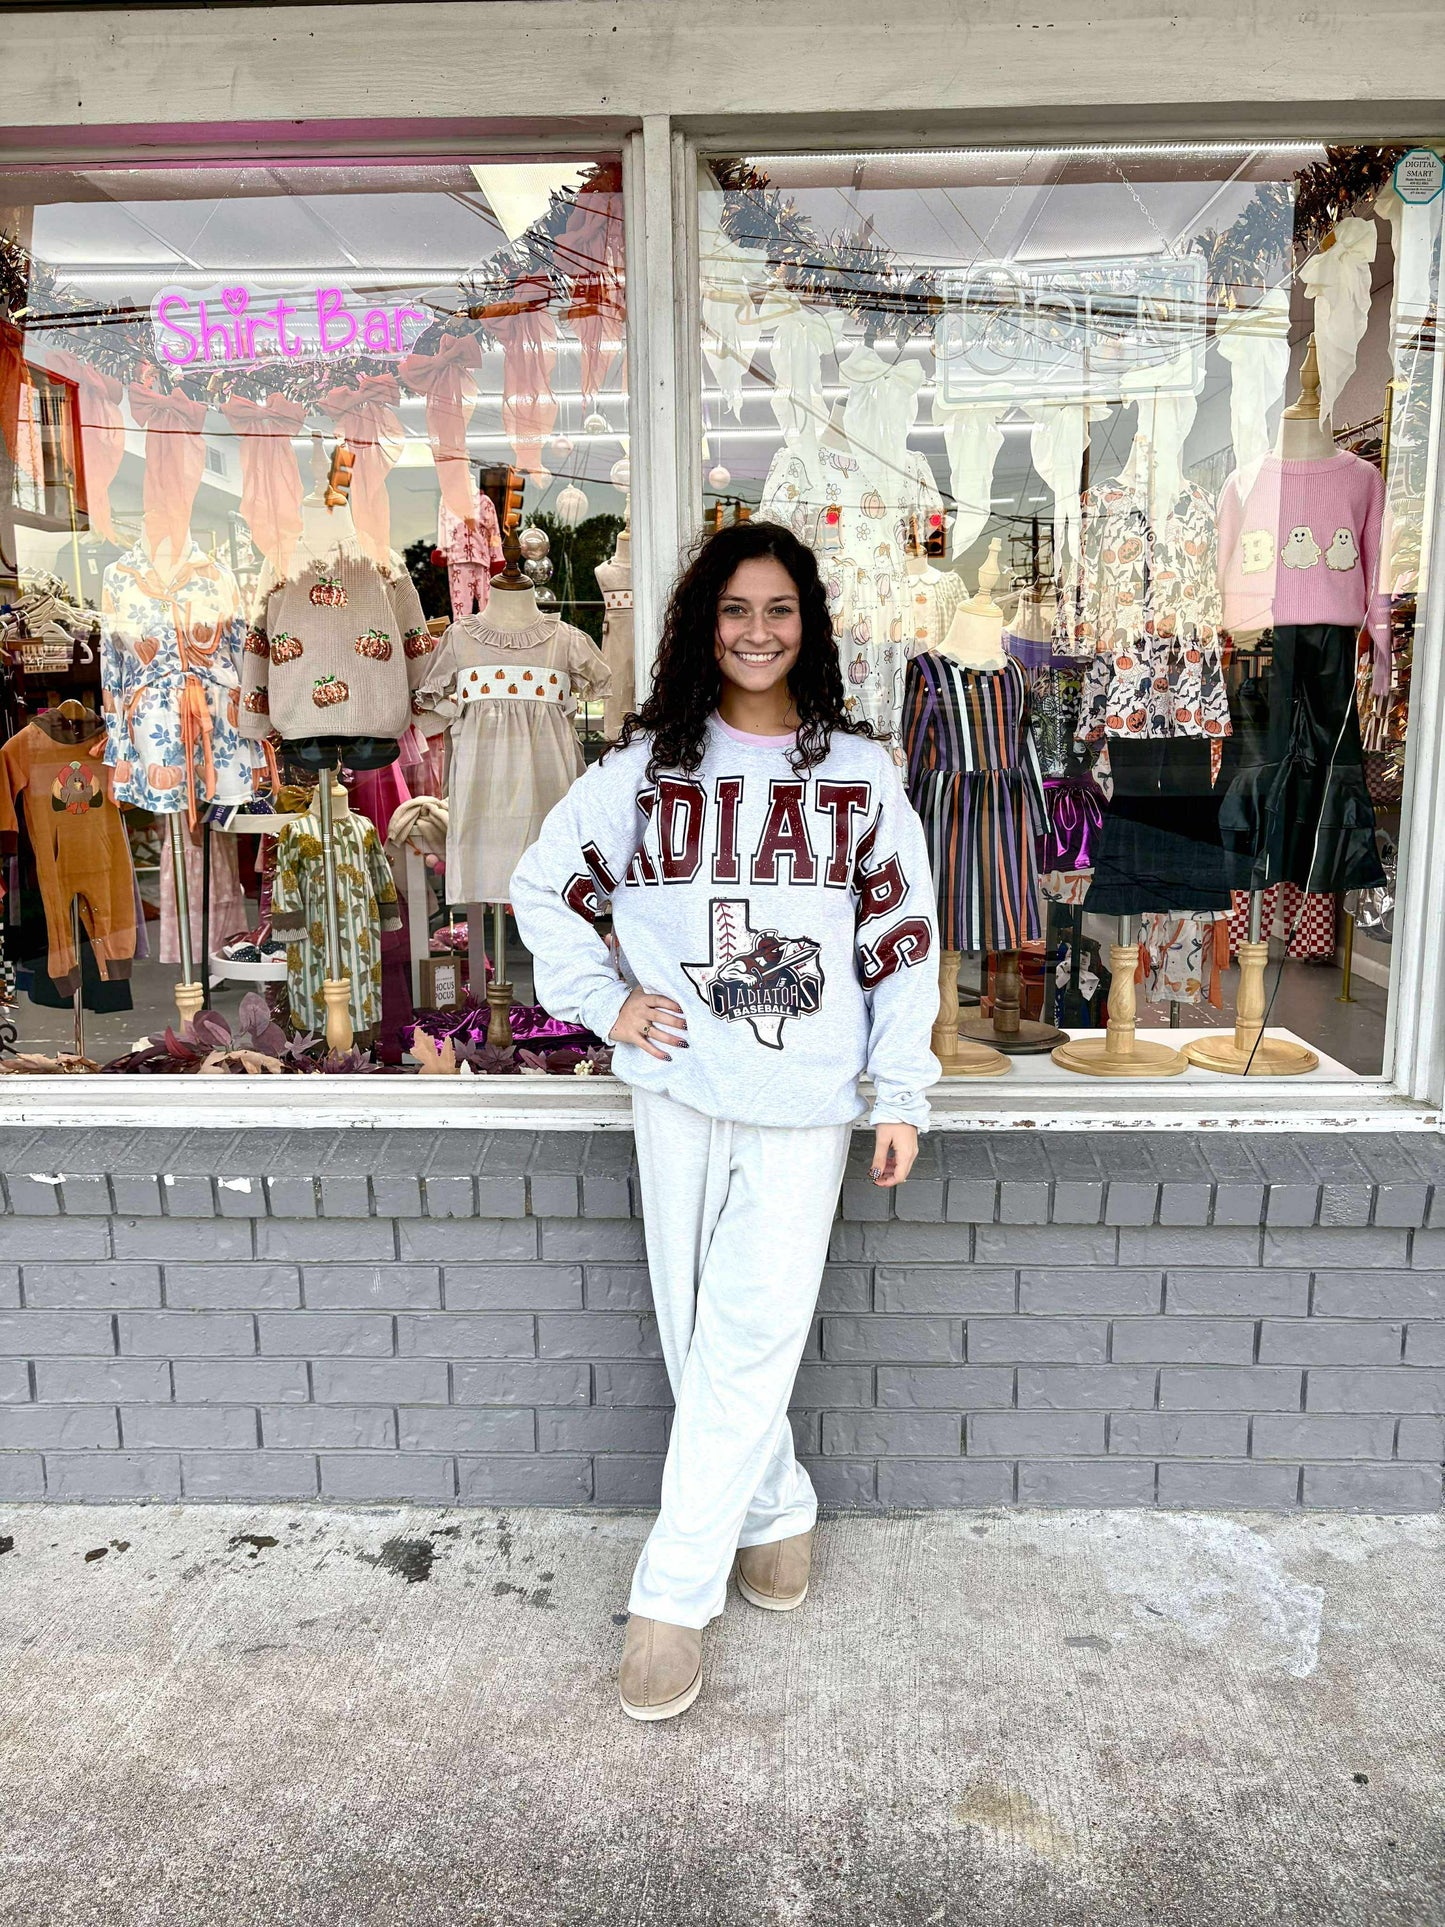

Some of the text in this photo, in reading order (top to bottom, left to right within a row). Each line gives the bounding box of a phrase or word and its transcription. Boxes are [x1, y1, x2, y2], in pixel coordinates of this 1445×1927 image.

[158, 286, 425, 366] Shirt Bar
[710, 977, 819, 1016] GLADIATORS
[732, 1004, 794, 1017] BASEBALL
